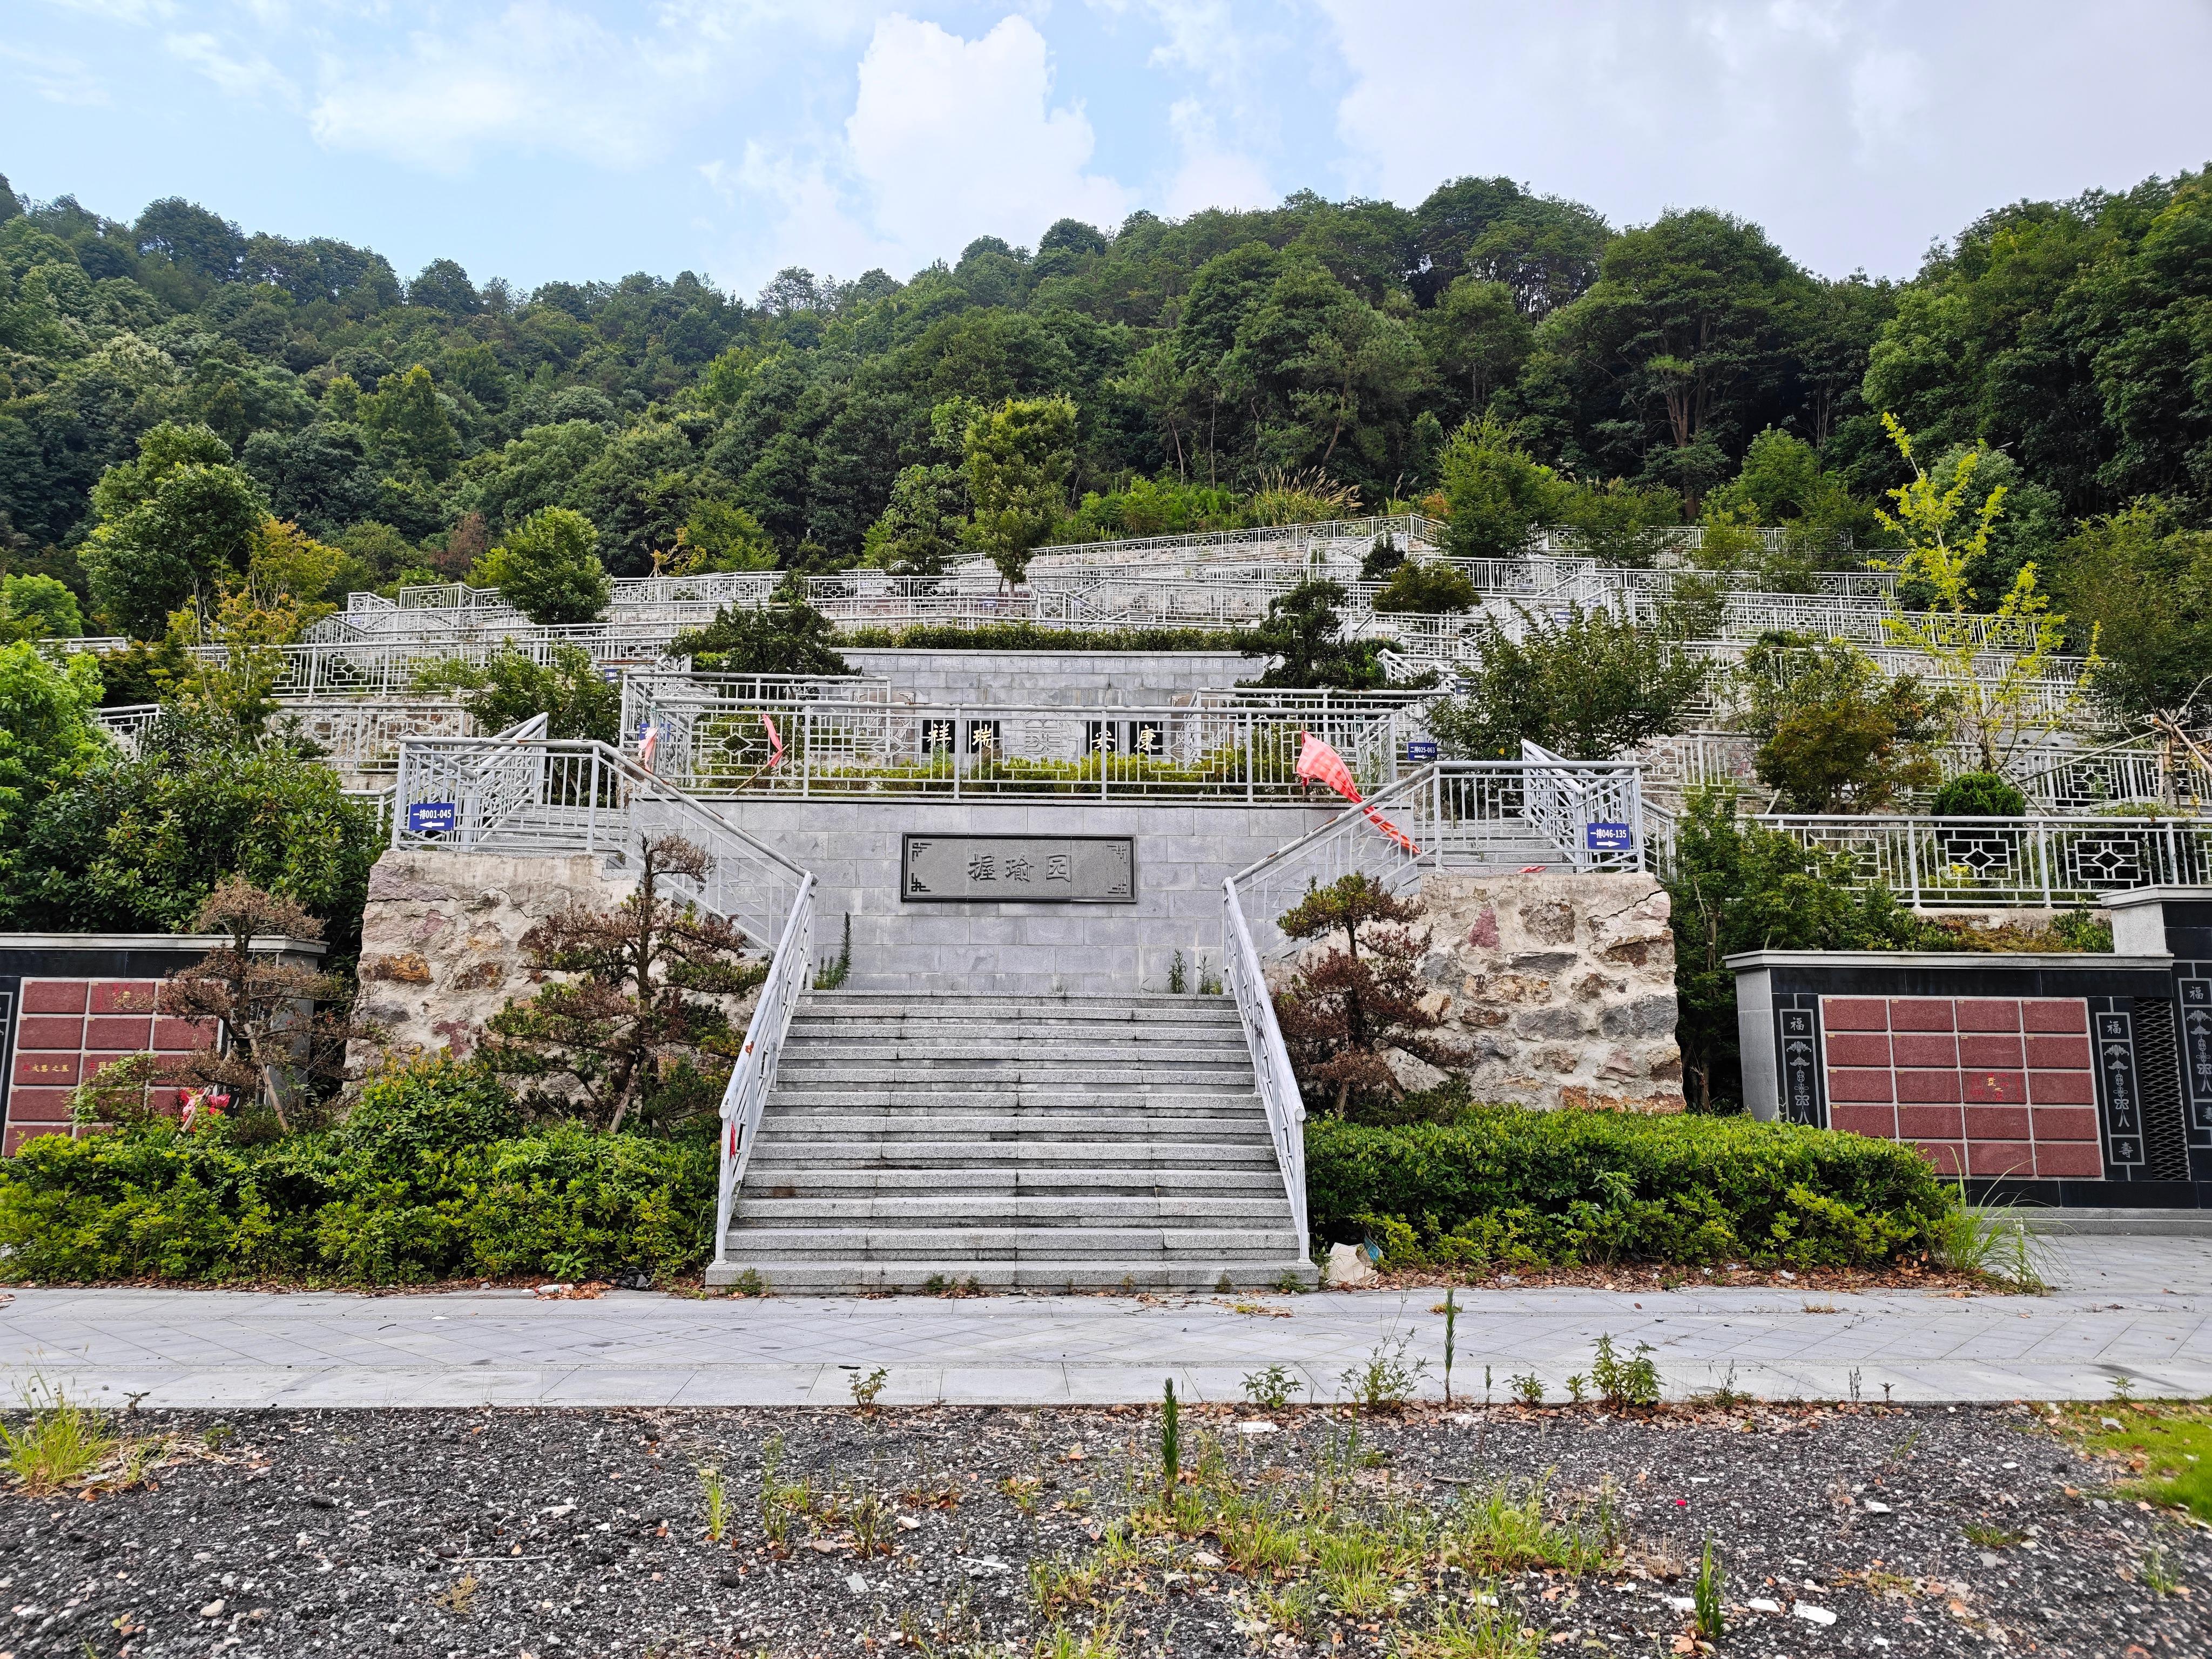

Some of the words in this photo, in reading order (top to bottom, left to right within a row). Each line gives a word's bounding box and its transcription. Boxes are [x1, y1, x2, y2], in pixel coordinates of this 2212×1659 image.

[413, 809, 451, 820] 一排001-045
[1590, 828, 1627, 839] 一排046-135
[968, 854, 1072, 882] 握瑜园
[2189, 986, 2204, 1000] 福
[1790, 1016, 1805, 1031] 福
[2107, 1020, 2122, 1035] 福
